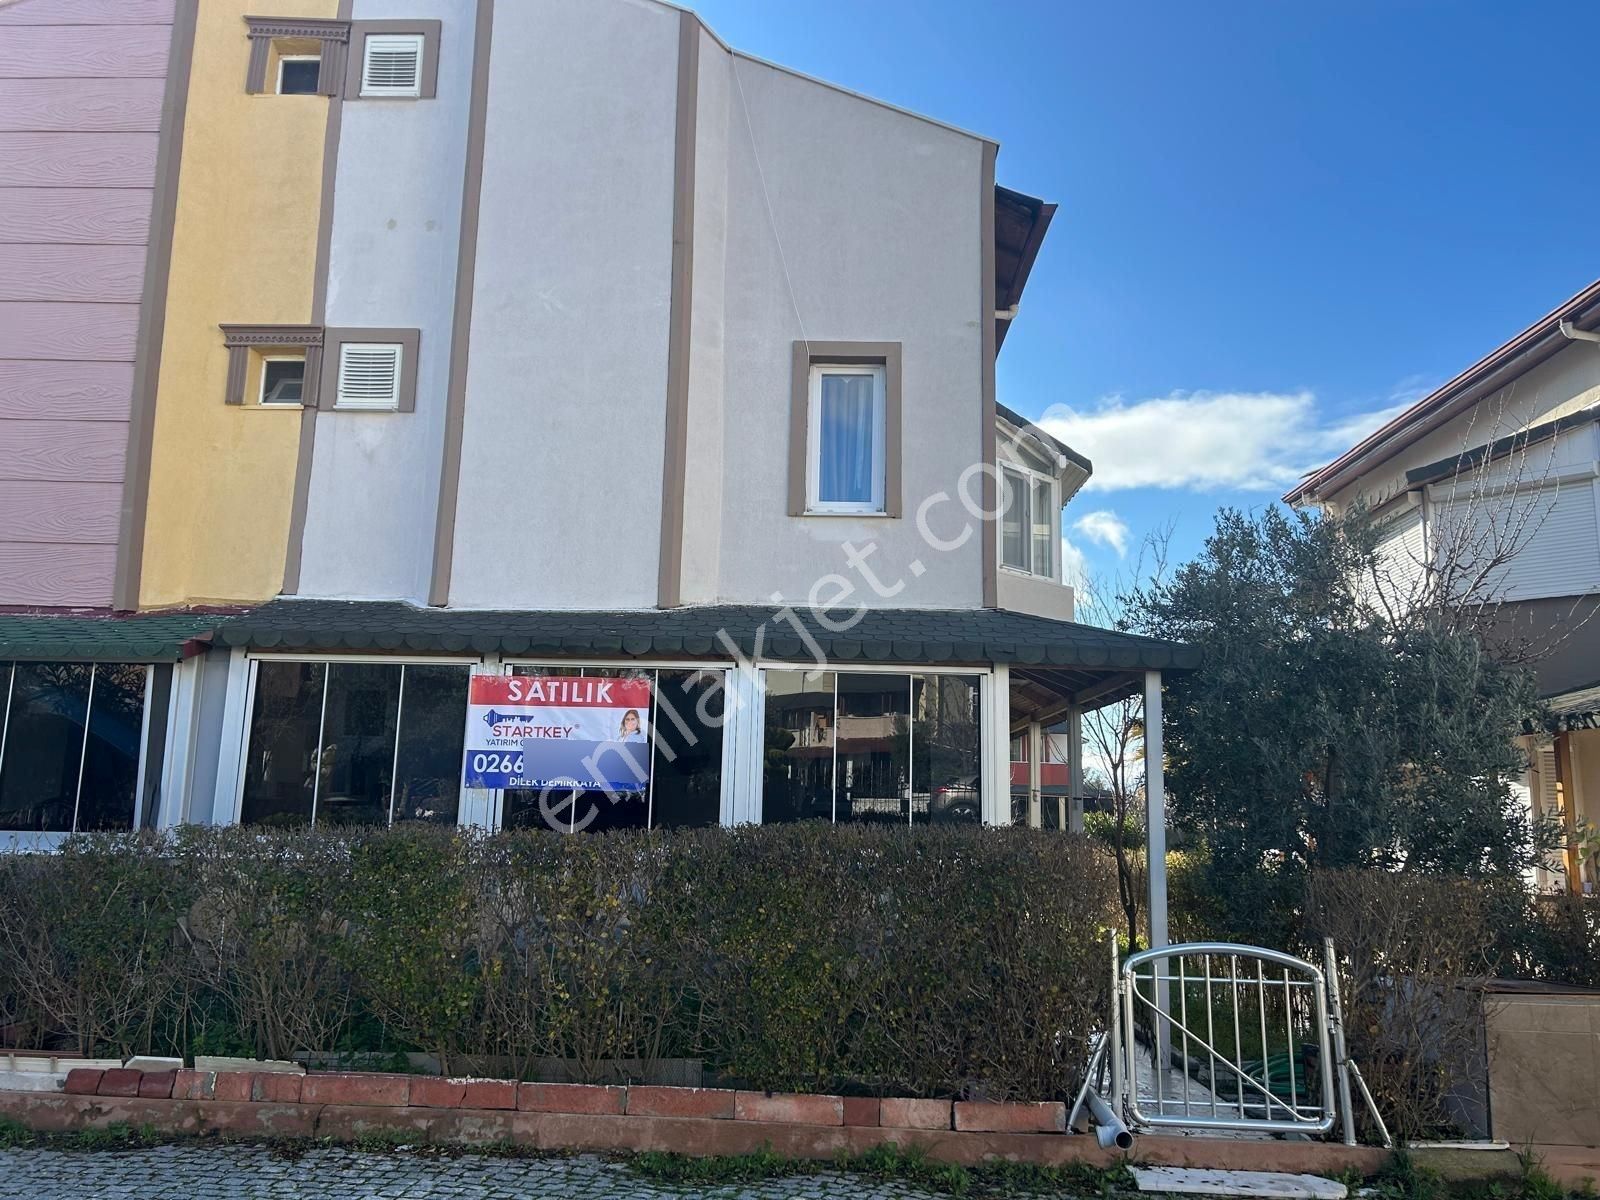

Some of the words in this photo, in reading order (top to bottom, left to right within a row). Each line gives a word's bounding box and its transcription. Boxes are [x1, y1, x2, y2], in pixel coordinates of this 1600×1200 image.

[507, 680, 613, 704] SATILIK
[492, 725, 573, 738] STARTKEY
[486, 738, 518, 747] YATIRIM
